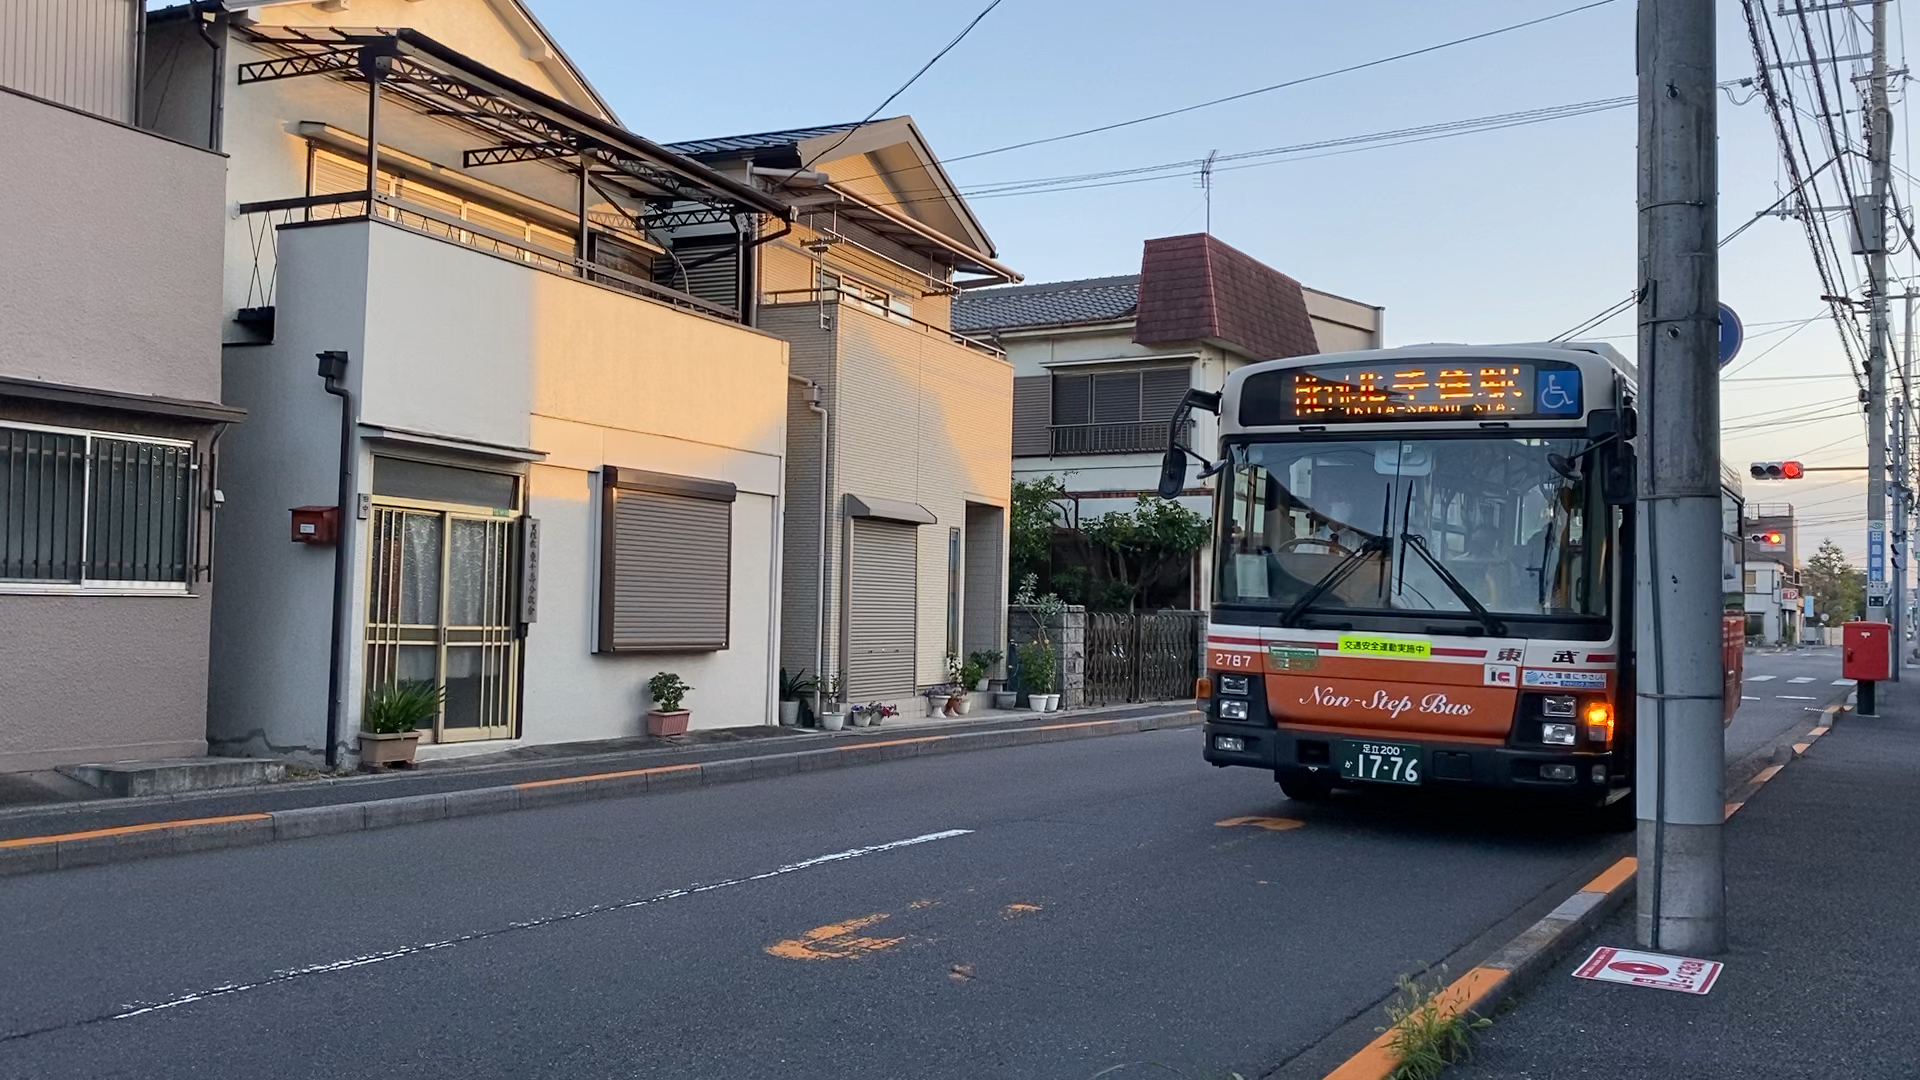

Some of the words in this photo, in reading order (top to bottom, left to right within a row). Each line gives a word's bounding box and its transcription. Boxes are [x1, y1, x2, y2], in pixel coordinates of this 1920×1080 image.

[1344, 640, 1425, 654] 交通安全運動実施中
[1215, 652, 1252, 667] 2787
[1538, 672, 1606, 681] 人と環境にやさしい
[1299, 685, 1416, 719] Non-Step
[1419, 692, 1475, 716] Bus
[1362, 743, 1400, 756] 足立200
[1358, 753, 1418, 783] 17-76
